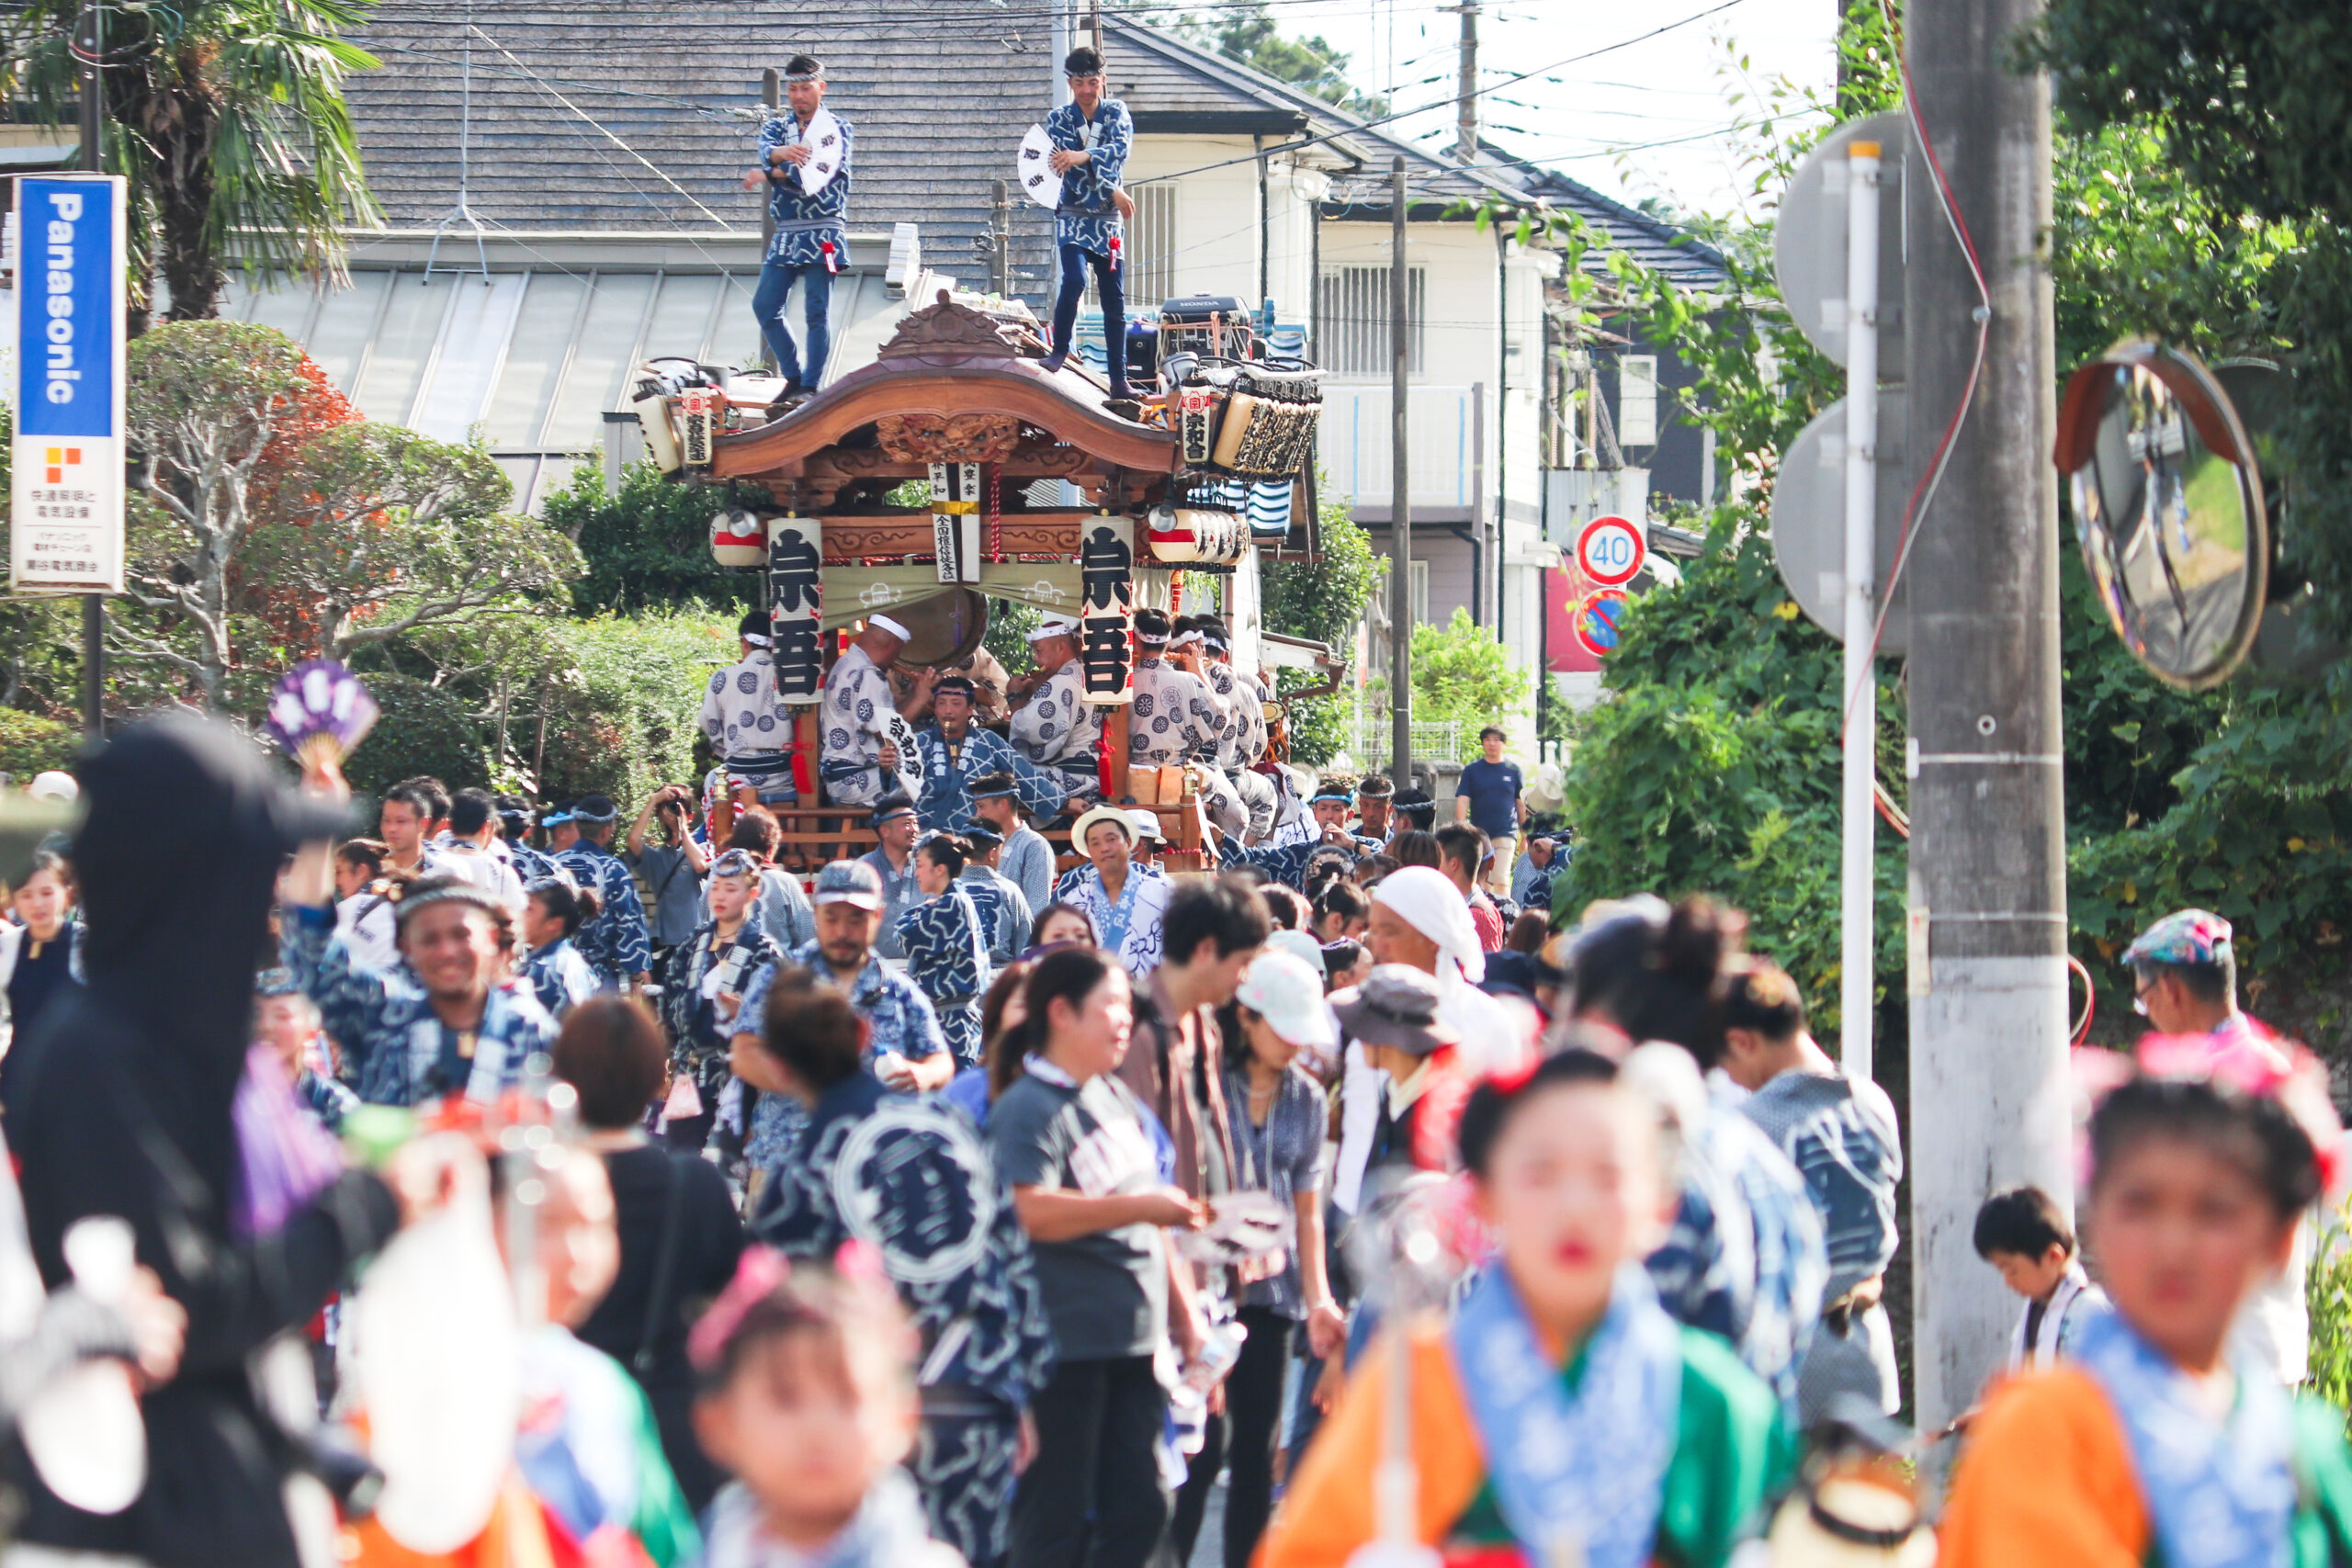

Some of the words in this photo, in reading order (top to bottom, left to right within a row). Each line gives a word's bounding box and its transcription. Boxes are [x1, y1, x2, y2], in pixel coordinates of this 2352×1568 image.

[47, 193, 83, 405] Panasonic
[770, 528, 822, 696] 宗吾
[1081, 526, 1131, 695] 宗吾
[1592, 536, 1630, 566] 40
